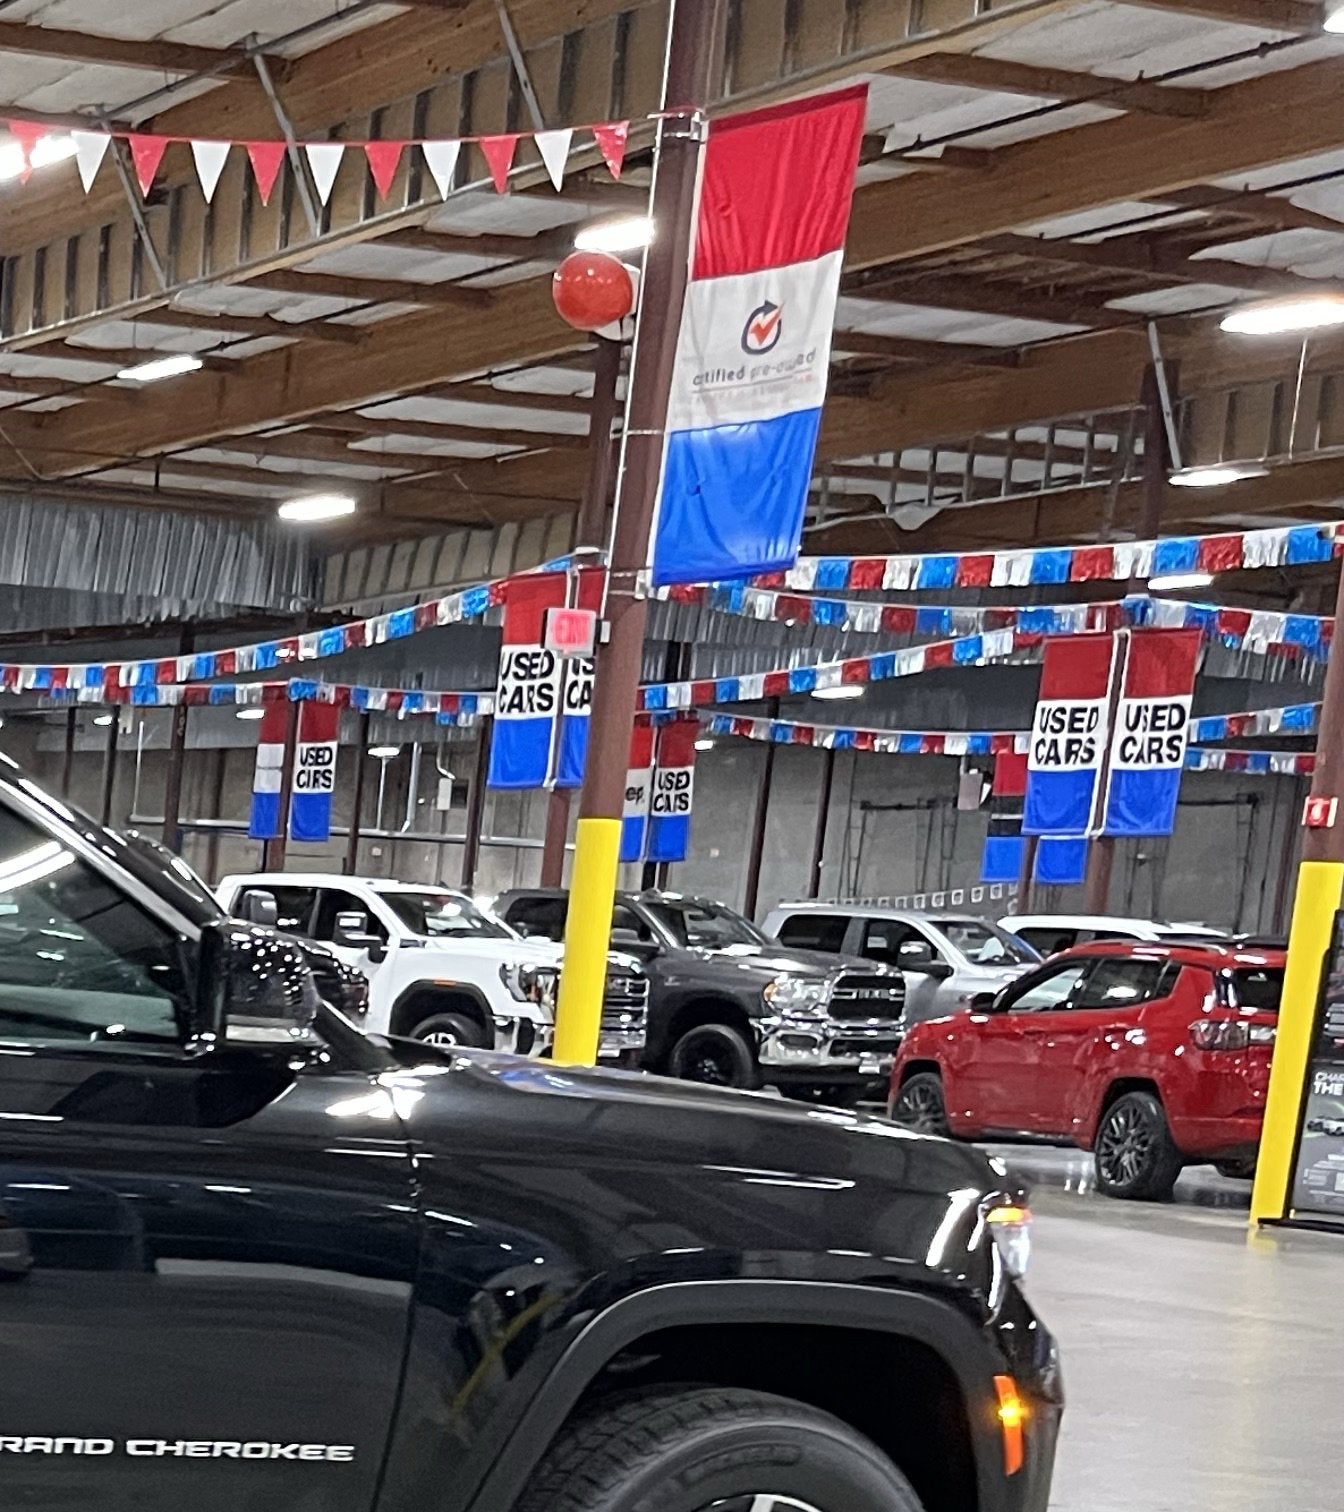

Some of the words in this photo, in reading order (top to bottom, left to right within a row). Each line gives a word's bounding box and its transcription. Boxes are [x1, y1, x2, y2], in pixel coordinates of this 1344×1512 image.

[501, 650, 555, 681] USED
[499, 683, 554, 713] CARS
[1040, 706, 1099, 734] USED
[1126, 703, 1186, 732] USED
[1035, 737, 1096, 765] CARS
[1120, 734, 1183, 763] CARS
[125, 1439, 356, 1462] CHEROKEE
